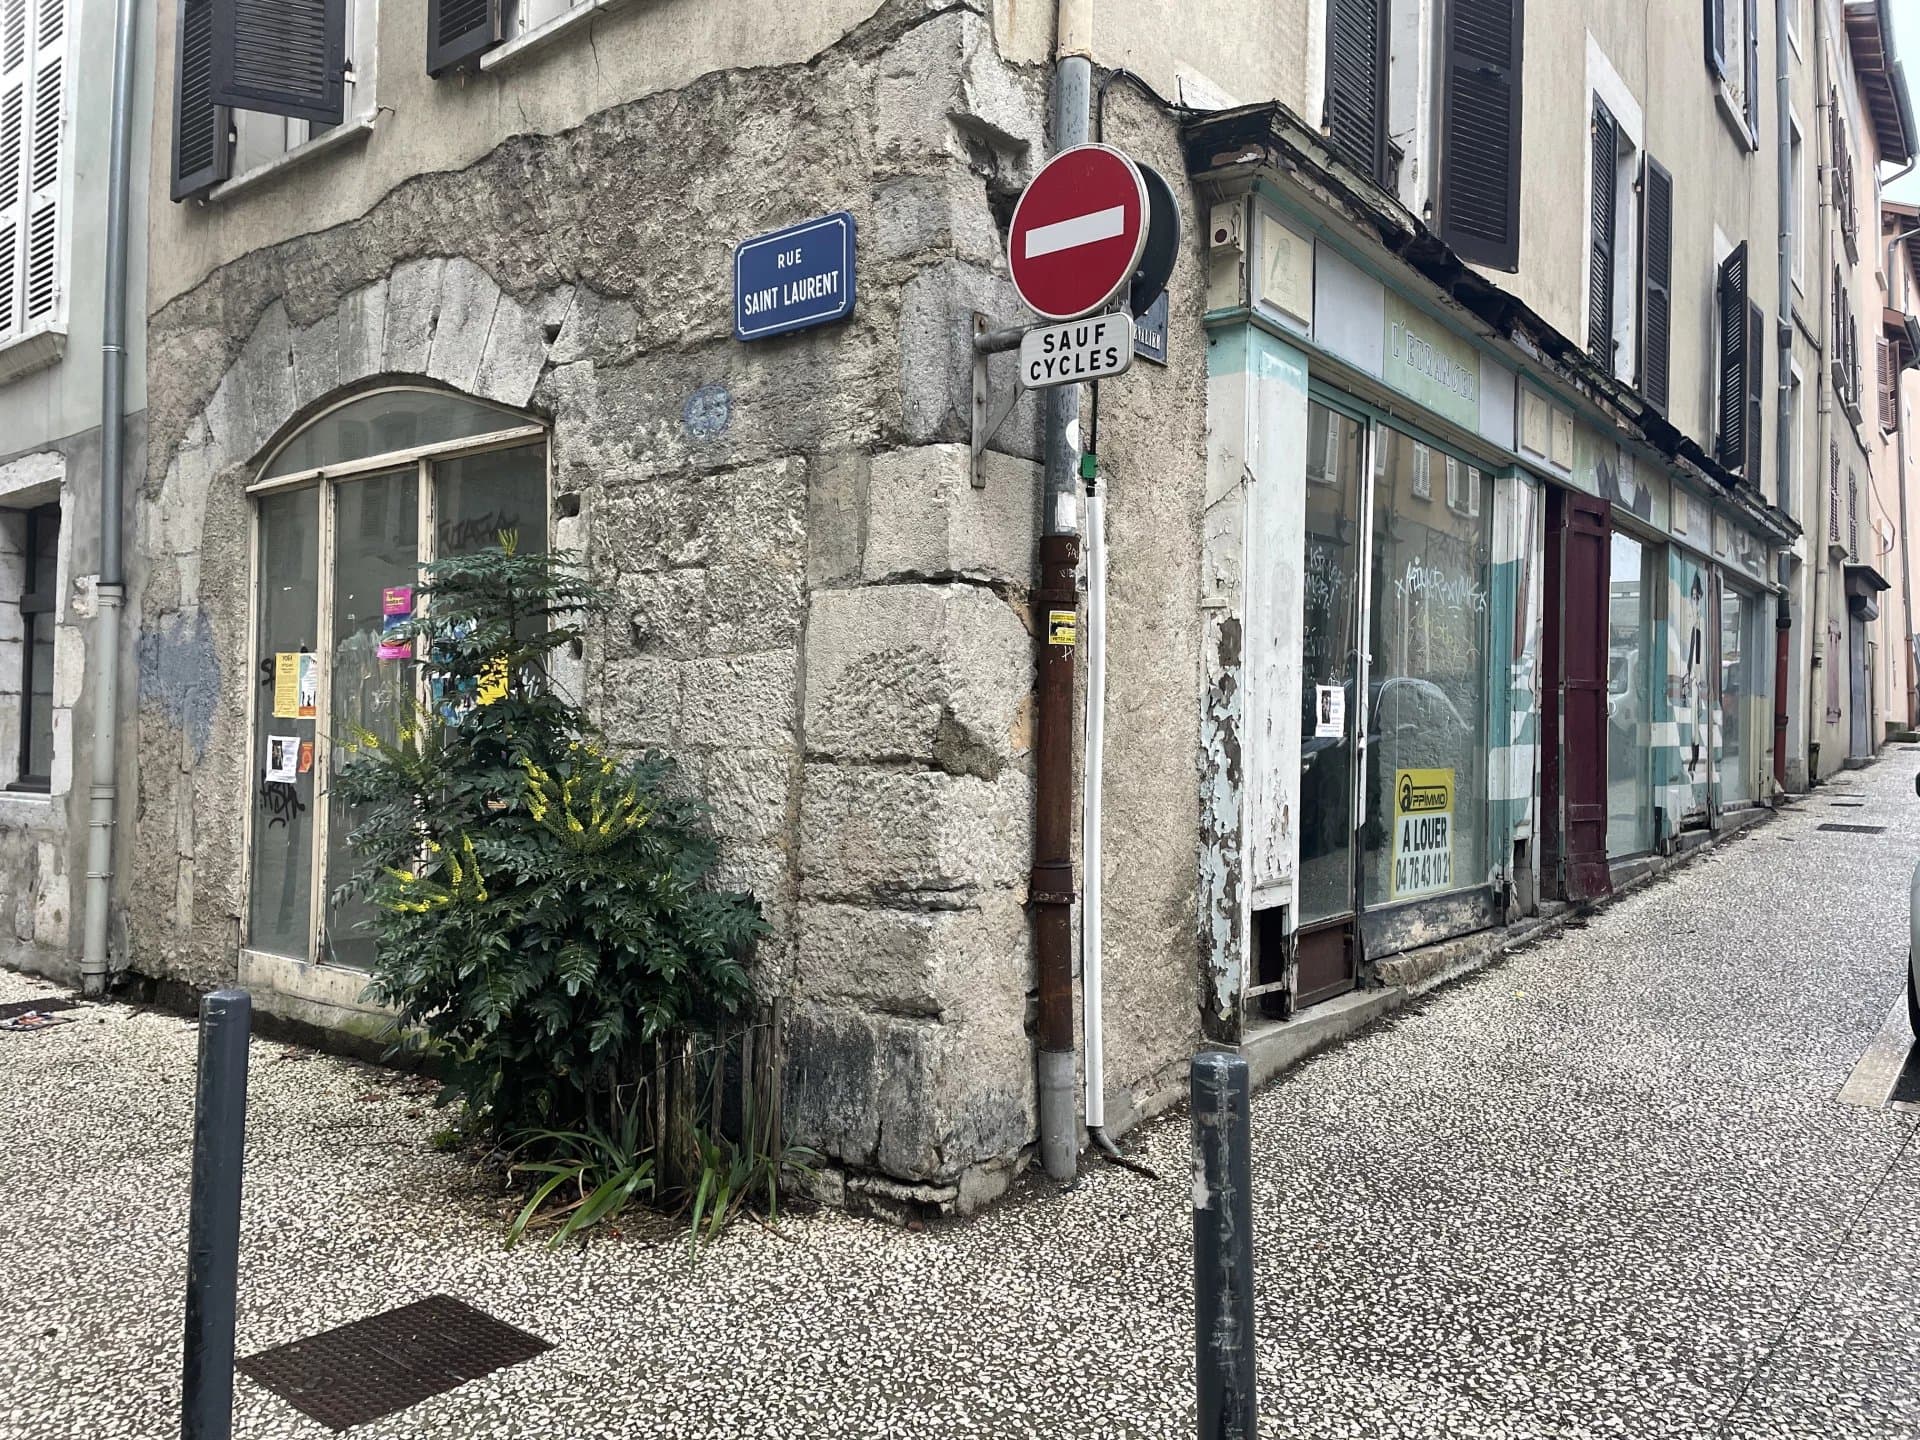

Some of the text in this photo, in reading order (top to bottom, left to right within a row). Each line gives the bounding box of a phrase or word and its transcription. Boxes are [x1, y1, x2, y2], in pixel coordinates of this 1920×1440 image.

[777, 248, 802, 269] RUE
[744, 270, 839, 316] SAINT LAURENT
[1043, 323, 1106, 354] SAUF
[1030, 346, 1118, 381] CYCLES
[1402, 816, 1447, 853] A LOUER
[1395, 850, 1451, 892] 04 76 43 10 21
